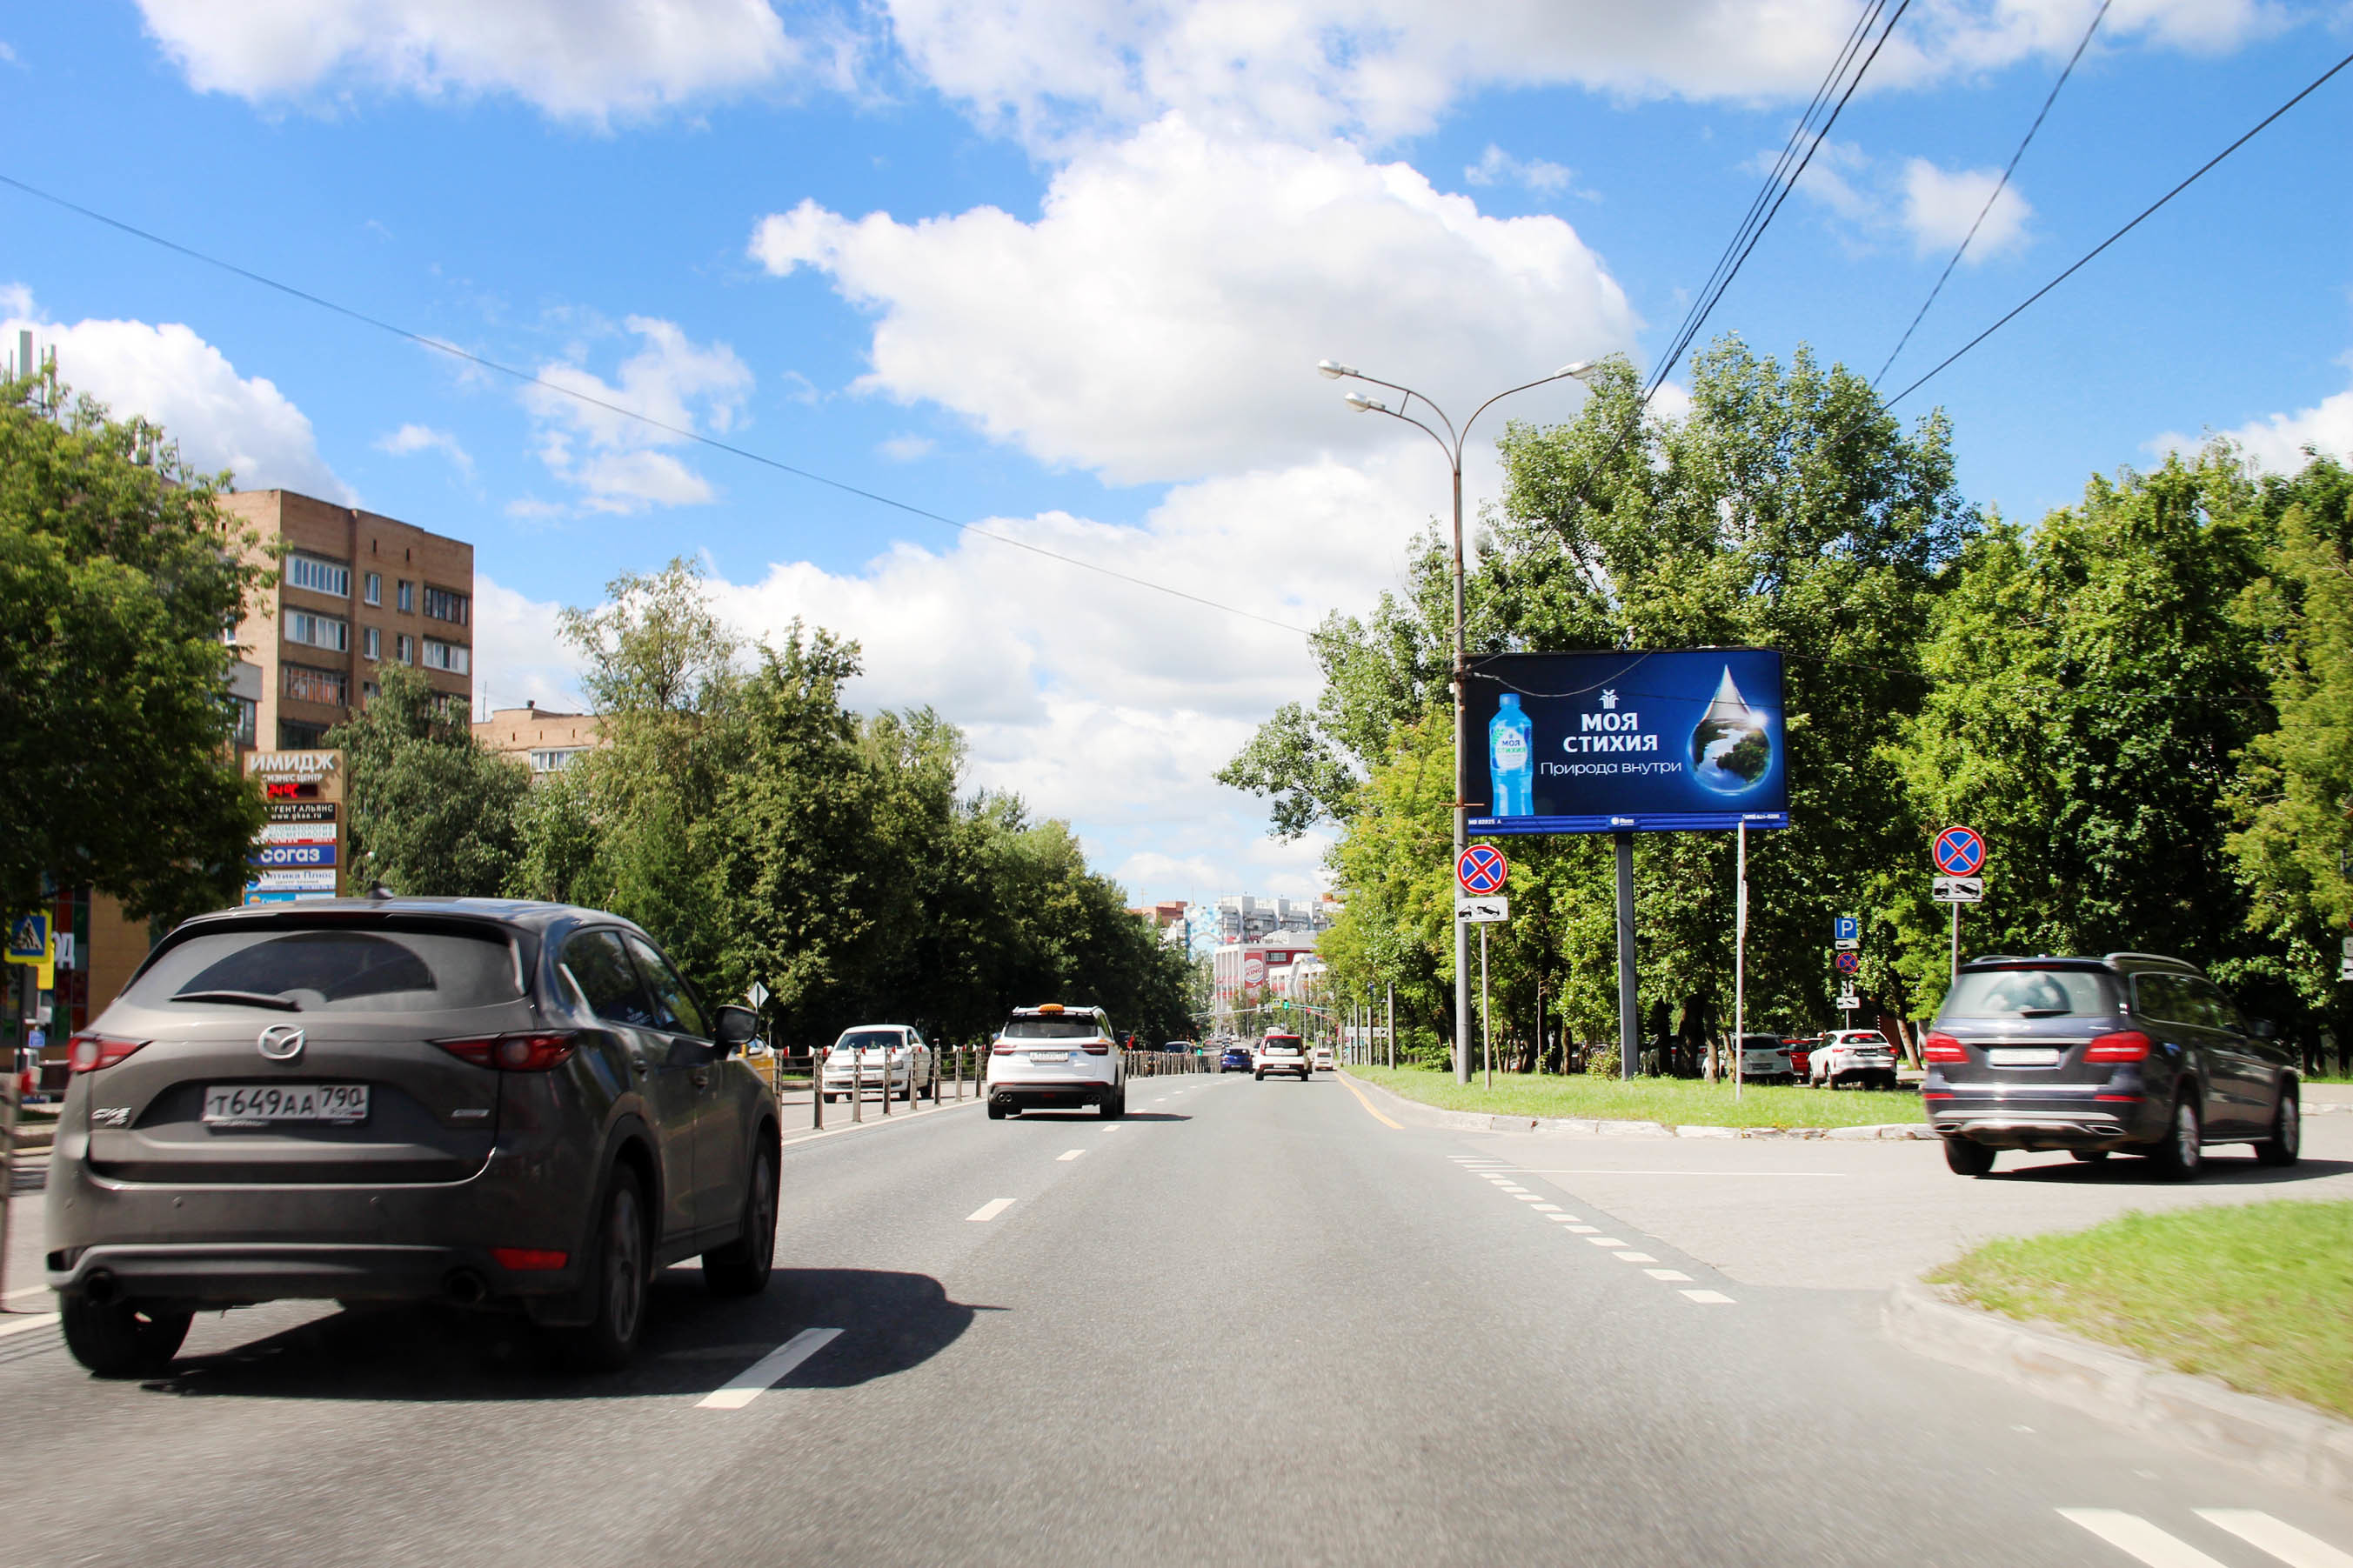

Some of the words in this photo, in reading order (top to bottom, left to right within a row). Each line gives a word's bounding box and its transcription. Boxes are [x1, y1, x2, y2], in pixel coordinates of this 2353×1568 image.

[1581, 712, 1637, 731] МОЯ
[1563, 735, 1658, 753] СТИХИЯ
[250, 754, 335, 773] ИМИДЖ
[1541, 762, 1618, 776] Природа
[1621, 762, 1682, 775] внутри
[297, 773, 323, 783] ЦЕНТР
[299, 804, 334, 813] АЛЬЯНС
[261, 848, 320, 863] согаз
[304, 870, 334, 879] Плюс
[1842, 920, 1854, 937] P
[320, 1087, 364, 1107] 790
